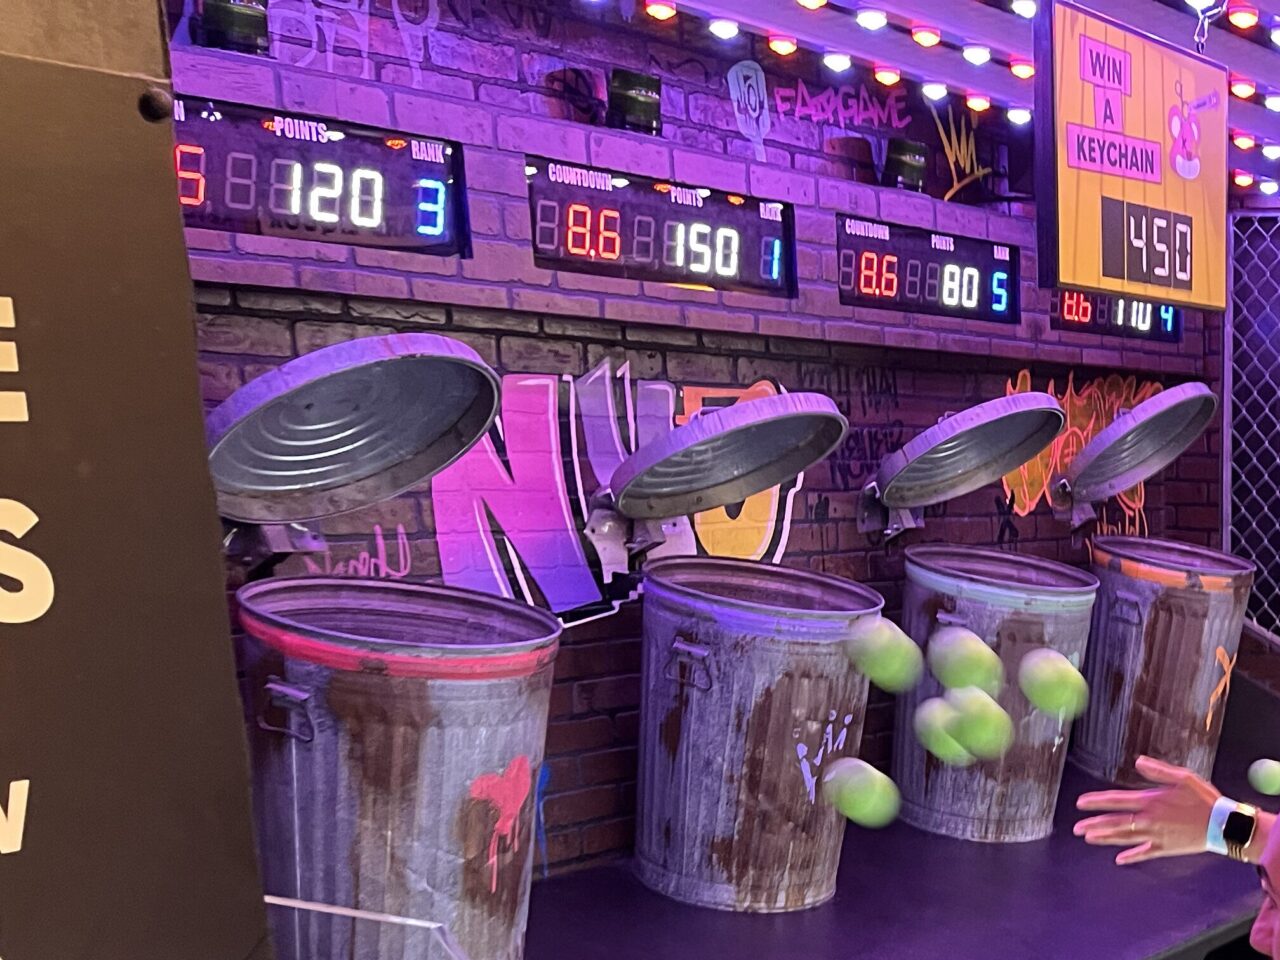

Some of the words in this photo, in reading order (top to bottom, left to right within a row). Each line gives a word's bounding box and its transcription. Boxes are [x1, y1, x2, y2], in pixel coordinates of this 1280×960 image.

[1089, 49, 1122, 86] WIN
[1103, 98, 1115, 125] A
[274, 116, 329, 143] POINTS
[411, 140, 445, 164] RANK
[1076, 133, 1155, 175] KEYCHAIN
[290, 162, 383, 228] 120
[416, 178, 446, 236] 3
[548, 162, 613, 191] COUNTDOWN
[670, 187, 704, 208] POINTS
[567, 203, 621, 260] 8.6
[675, 222, 739, 276] 150
[771, 238, 782, 280] 1
[845, 218, 890, 241] COUNTDOWN
[1129, 215, 1191, 281] 450
[860, 251, 898, 298] 8.6
[942, 263, 979, 308] 80
[991, 271, 1008, 312] 5
[1160, 305, 1174, 332] 4
